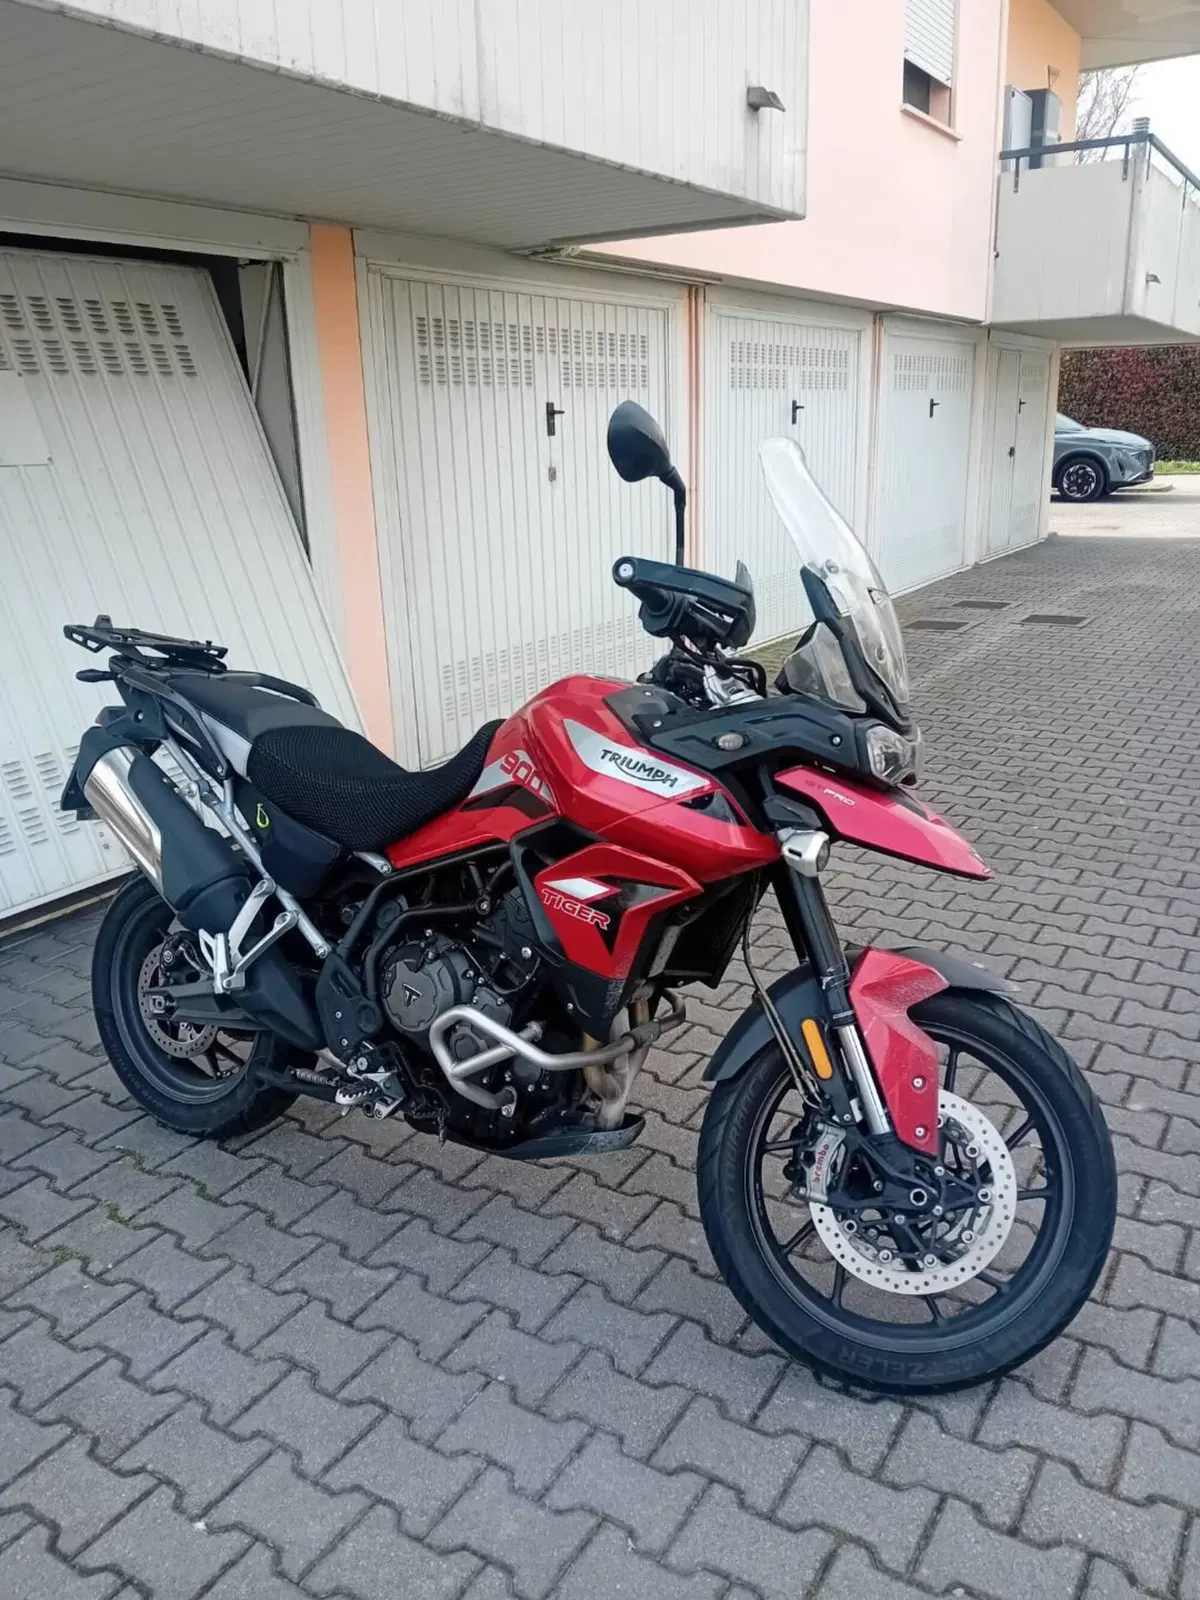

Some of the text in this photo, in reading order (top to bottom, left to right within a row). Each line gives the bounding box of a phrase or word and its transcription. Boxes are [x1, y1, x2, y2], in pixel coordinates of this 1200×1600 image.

[500, 752, 543, 796] 900
[599, 749, 678, 788] TRIUMPH
[823, 788, 856, 806] PRO
[541, 889, 611, 931] TIGER
[812, 1144, 830, 1184] brembo
